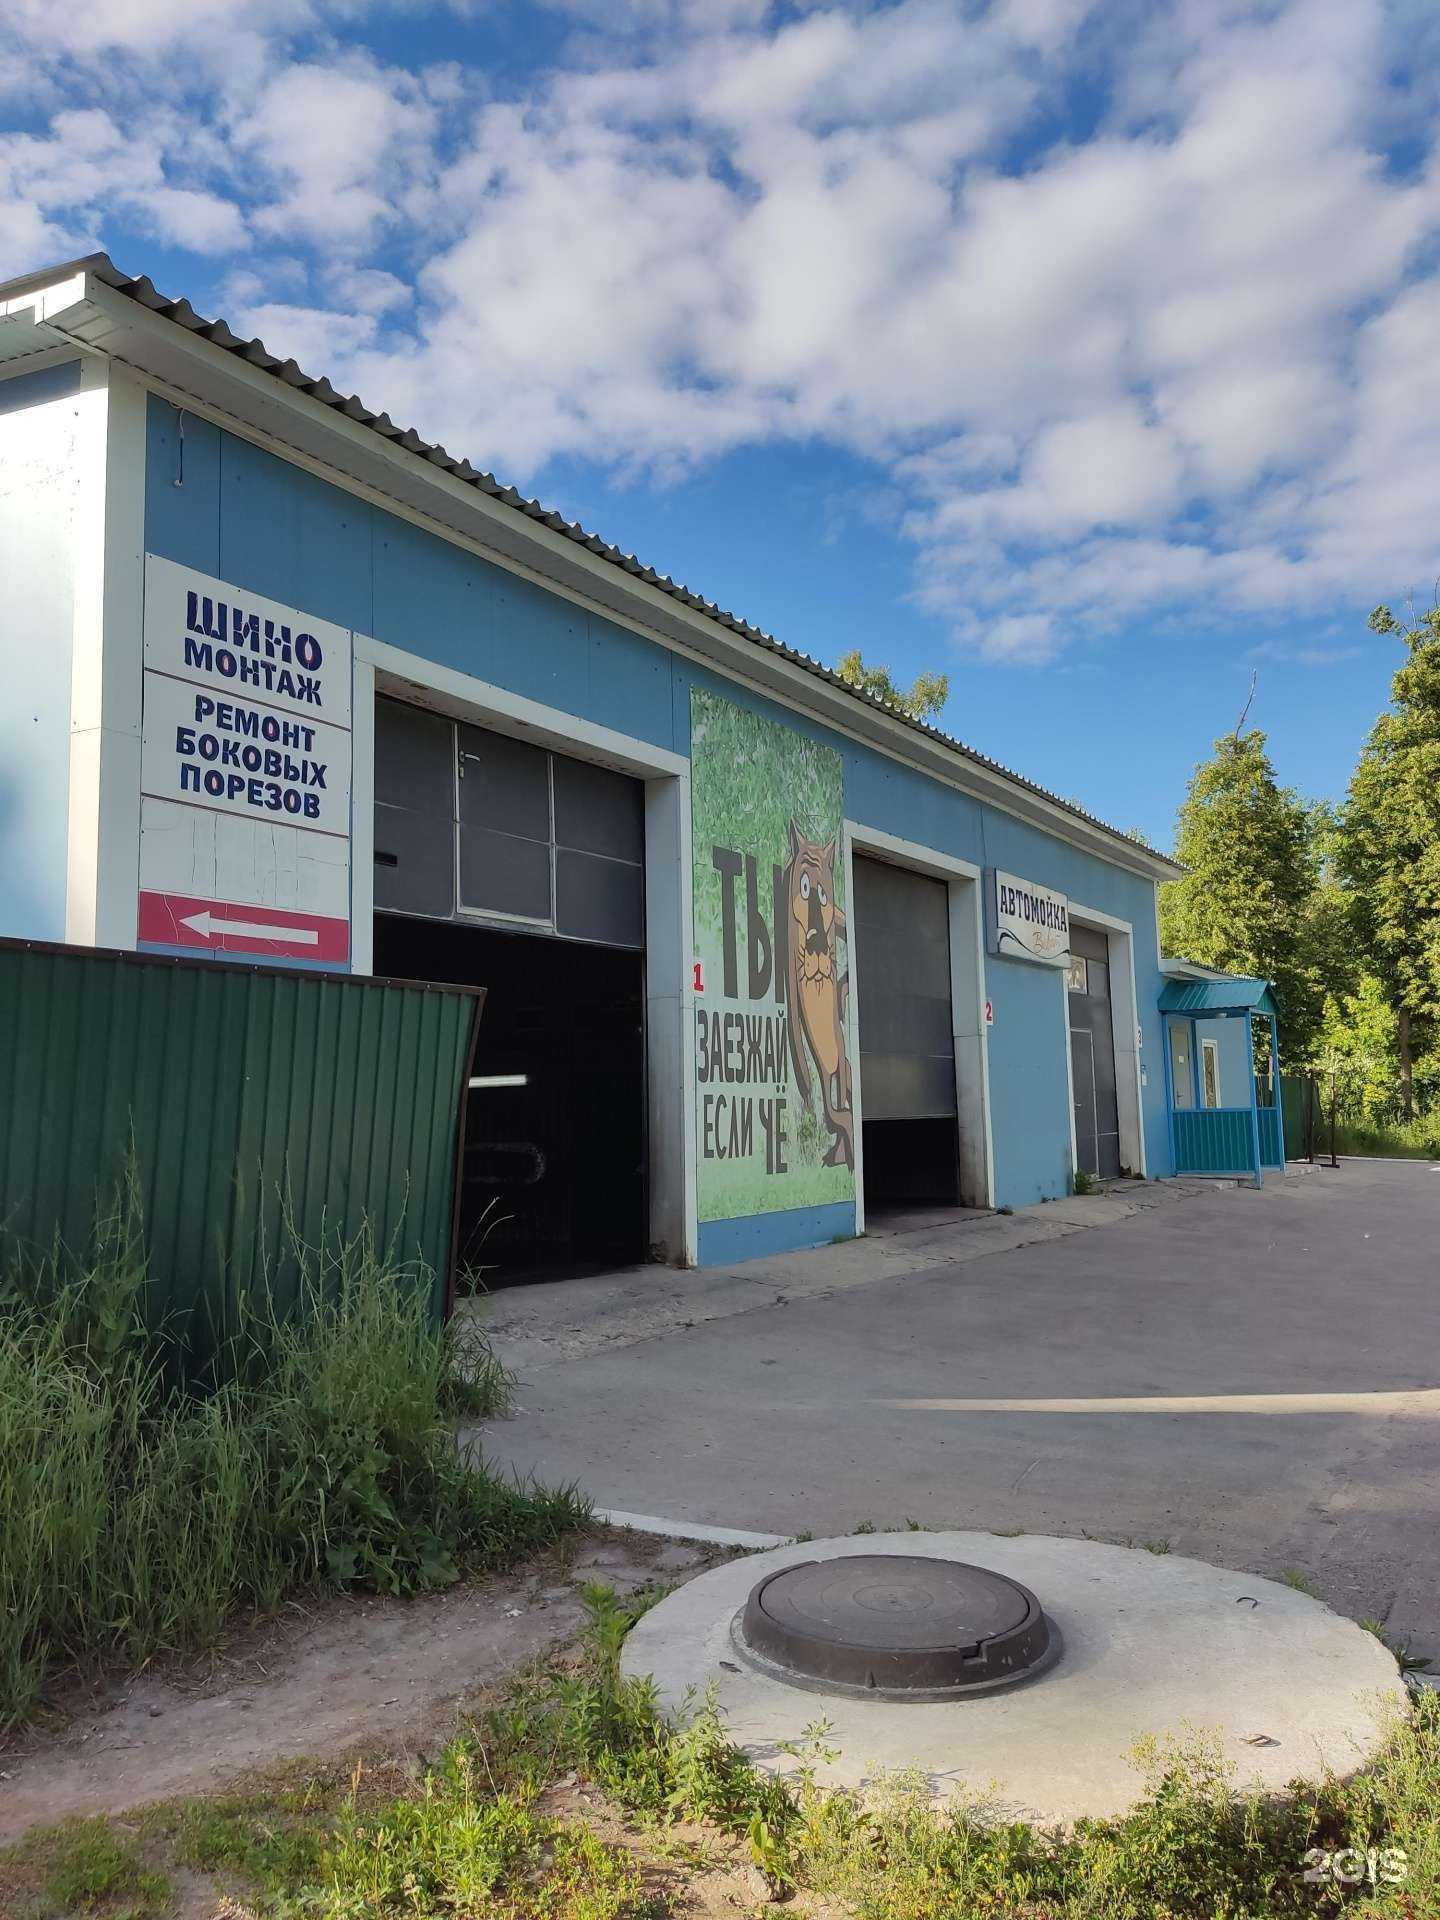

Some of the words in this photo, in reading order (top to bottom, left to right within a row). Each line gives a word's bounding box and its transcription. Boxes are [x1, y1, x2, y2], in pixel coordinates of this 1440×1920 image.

[186, 591, 323, 672] ШИНО
[184, 637, 323, 706] МОНТАЖ
[194, 694, 316, 753] РЕМОНТ
[176, 726, 328, 790] БОКОВЫХ
[180, 762, 321, 819] ПОРЕЗОВ
[712, 846, 787, 1004] ТЫ
[1000, 884, 1068, 933] АВТОМОЙКА
[693, 963, 704, 991] 1
[985, 1001, 993, 1022] 2
[697, 1008, 788, 1084] ЗАЕЗЖАЙ
[703, 1093, 753, 1160] ЕСЛИ
[759, 1084, 788, 1175] ЧЁ
